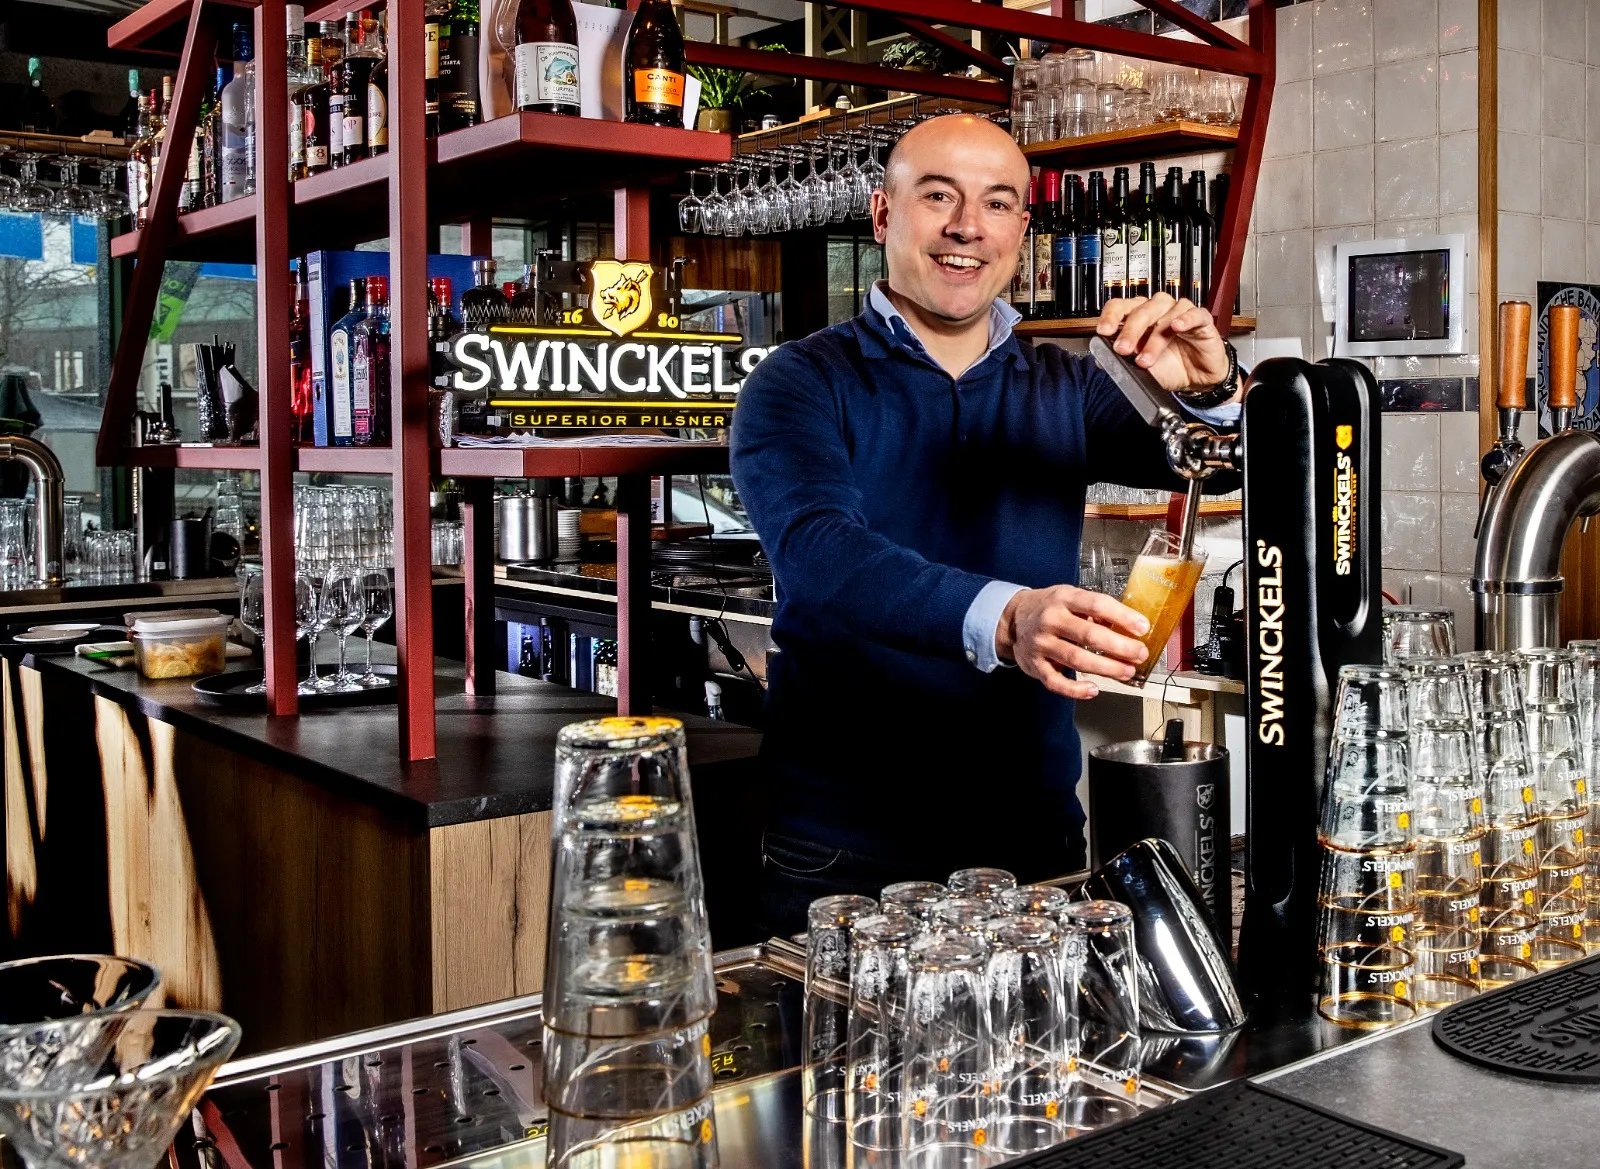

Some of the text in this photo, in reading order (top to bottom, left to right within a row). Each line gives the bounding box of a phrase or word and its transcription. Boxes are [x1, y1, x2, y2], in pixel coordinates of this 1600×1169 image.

[646, 73, 676, 83] CANTI
[562, 308, 680, 329] 16 80
[514, 414, 725, 427] SUPERIOR PILSNER
[1335, 451, 1352, 576] SWINCKELS'
[1256, 538, 1285, 746] SWINCKELS'
